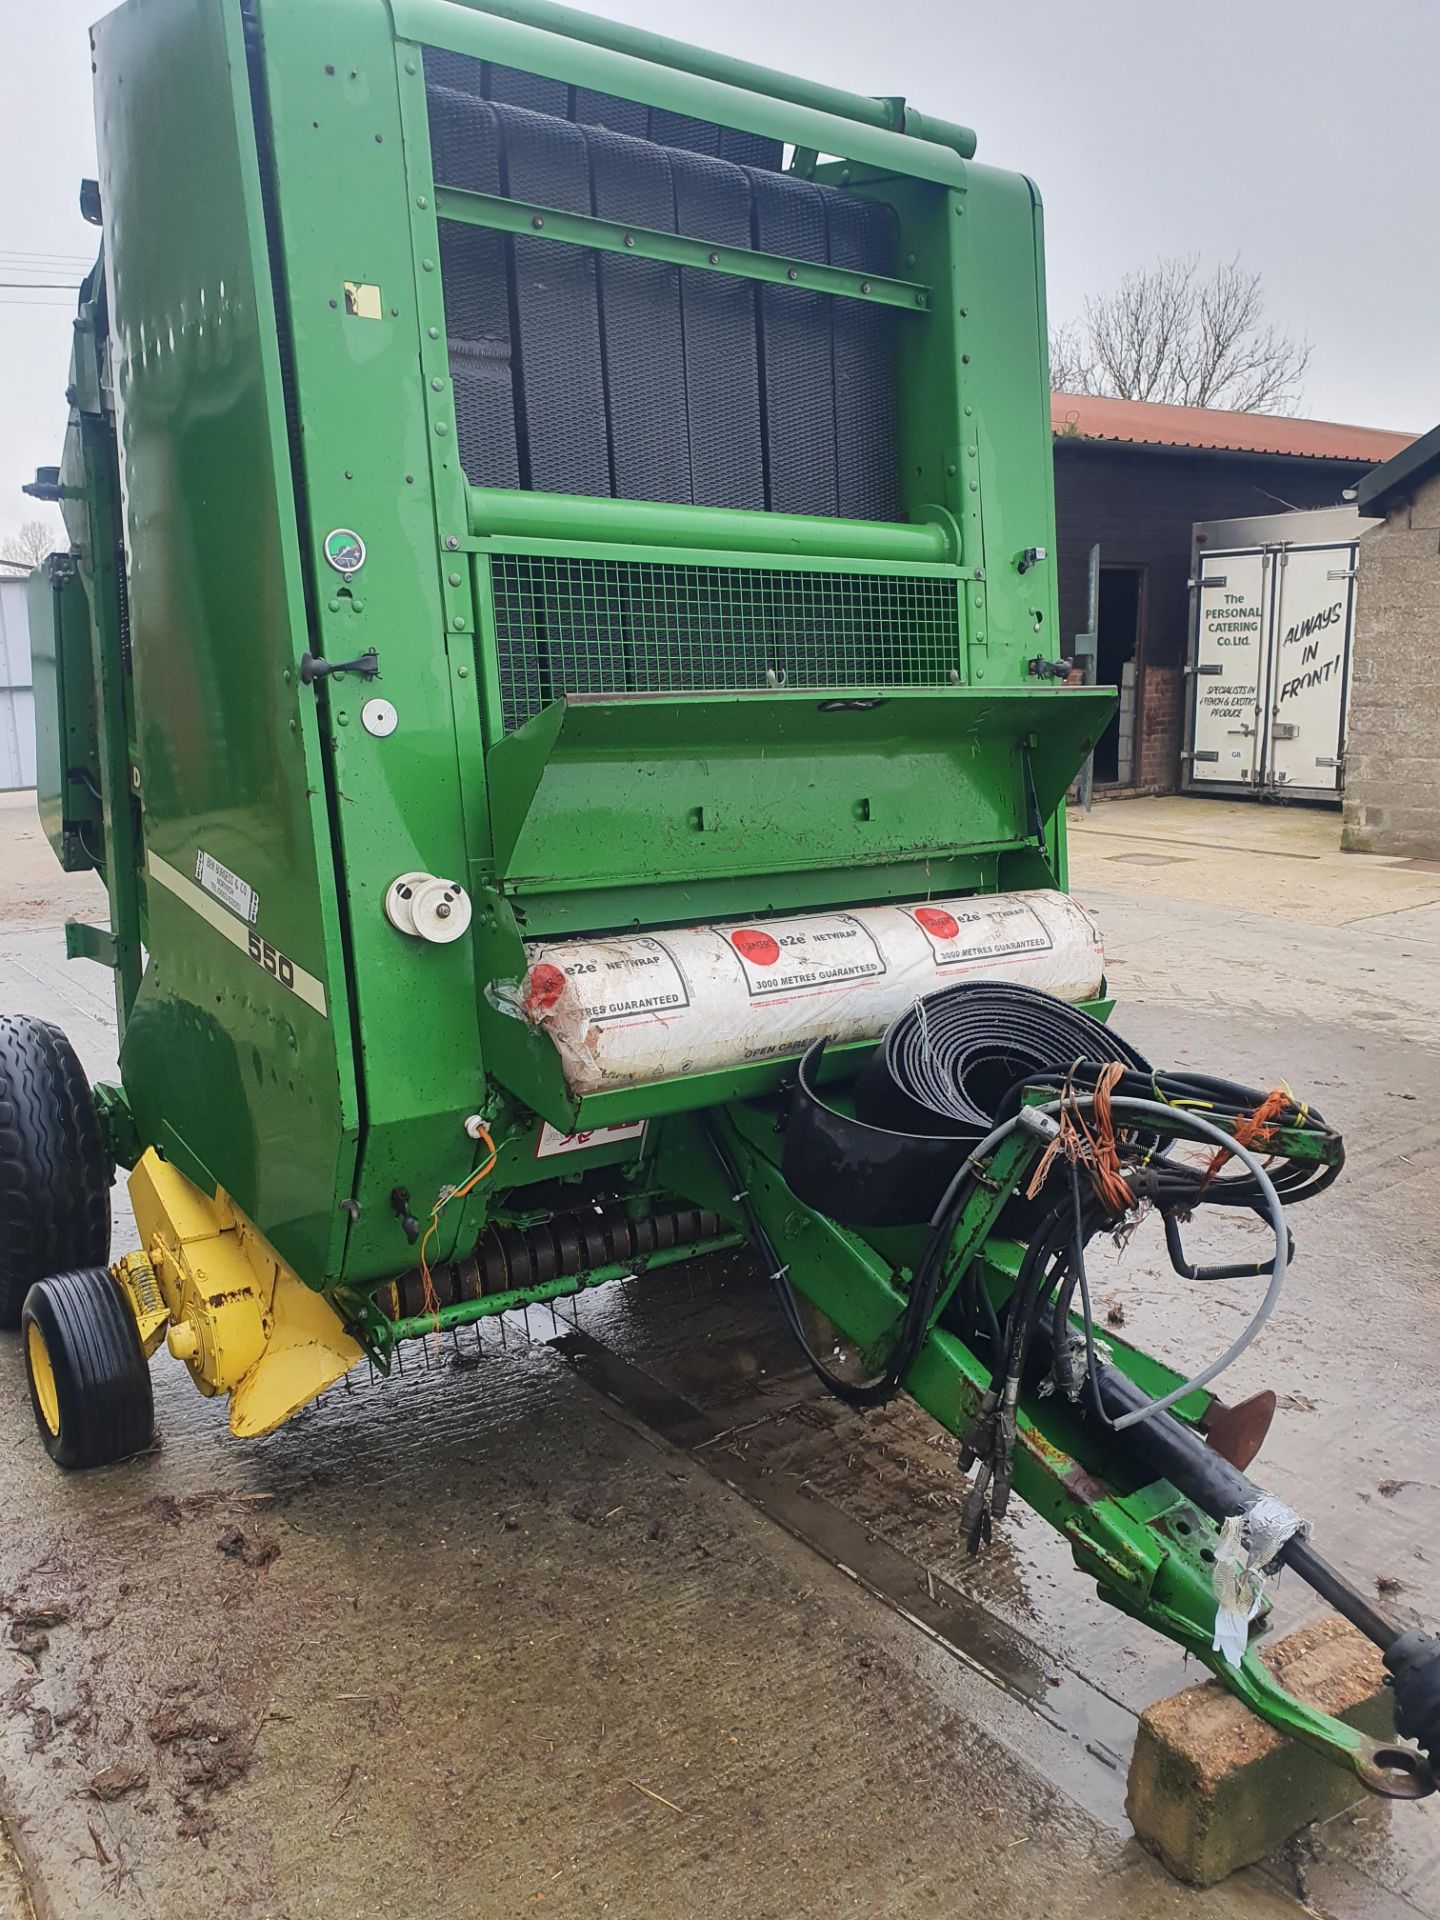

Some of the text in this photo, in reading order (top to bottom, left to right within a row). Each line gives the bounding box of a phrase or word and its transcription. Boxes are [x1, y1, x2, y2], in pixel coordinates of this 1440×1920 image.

[1224, 594, 1245, 604] The
[1205, 607, 1262, 619] PERSONAL
[1208, 622, 1258, 633] CATERING
[1282, 602, 1342, 648] ALWAYS
[1301, 641, 1319, 666] IN
[1280, 654, 1341, 703] FRONT!
[1206, 686, 1247, 695] SPECIALISTS
[1210, 708, 1243, 717] PRODUCE
[132, 766, 141, 788] D
[958, 913, 981, 923] e2e
[779, 935, 806, 947] e2e
[812, 930, 858, 942] NETWRAP
[940, 938, 1046, 960] 3000 METRES GUARANTEED
[248, 928, 294, 989] 550
[565, 963, 598, 976] e2e
[756, 963, 878, 990] 3000 METRES GUARANTEED
[608, 993, 680, 1013] GUARANTEED
[744, 1045, 776, 1058] OPEN
